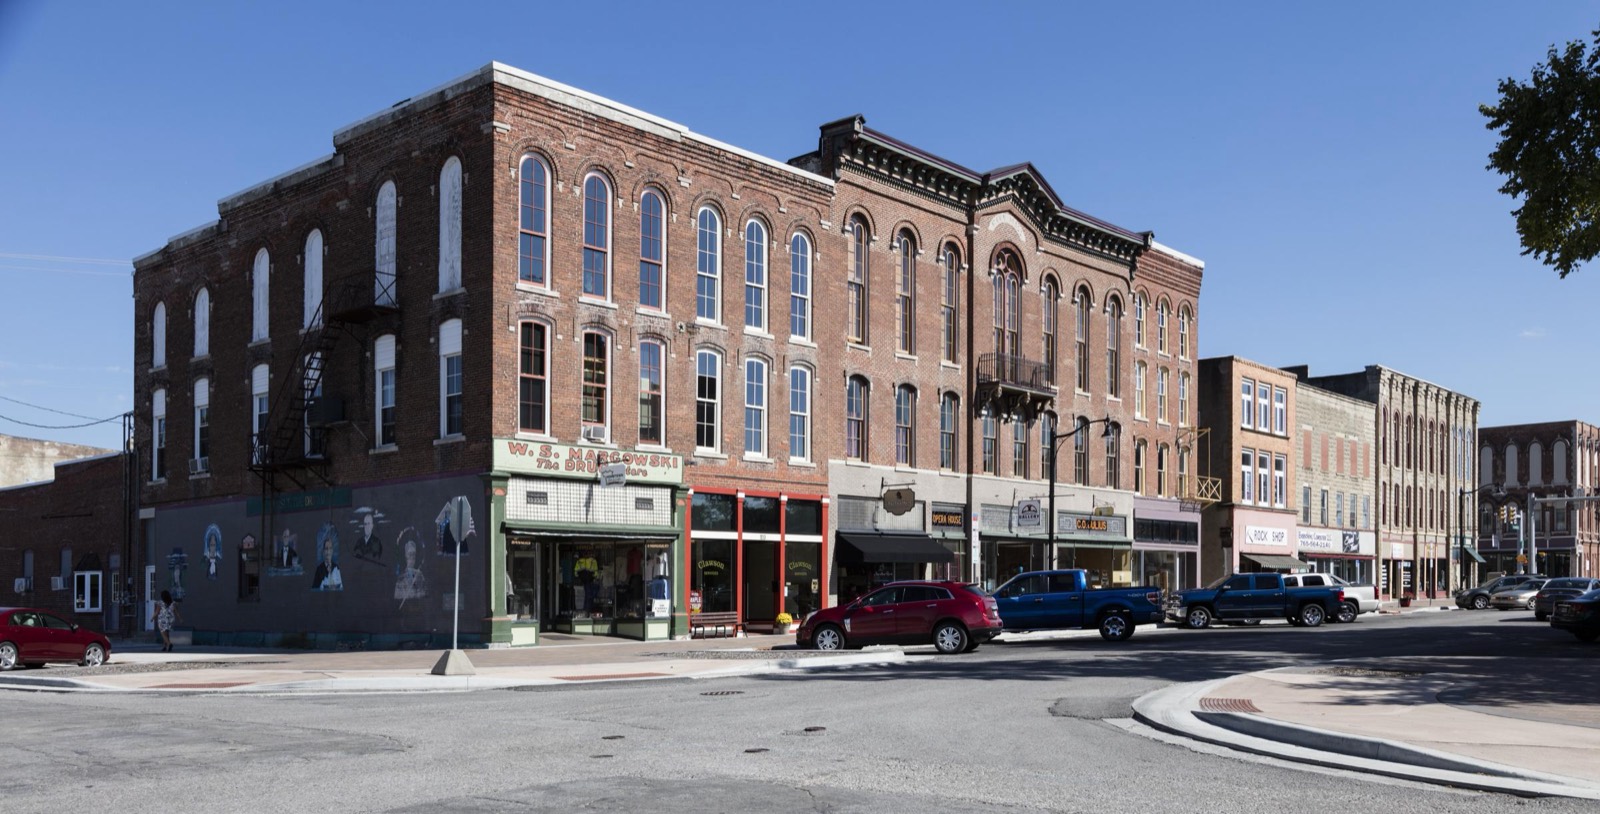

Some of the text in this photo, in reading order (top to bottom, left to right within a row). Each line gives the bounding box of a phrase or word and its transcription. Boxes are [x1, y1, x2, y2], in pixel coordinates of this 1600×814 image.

[508, 441, 678, 469] W. S. MARGOWSKI
[537, 457, 559, 470] The
[565, 459, 607, 474] DRU
[932, 513, 961, 525] OPERA HOUSE
[1254, 529, 1284, 542] ROCK SHOP
[697, 559, 725, 570] Clawson
[788, 561, 812, 570] Clawson
